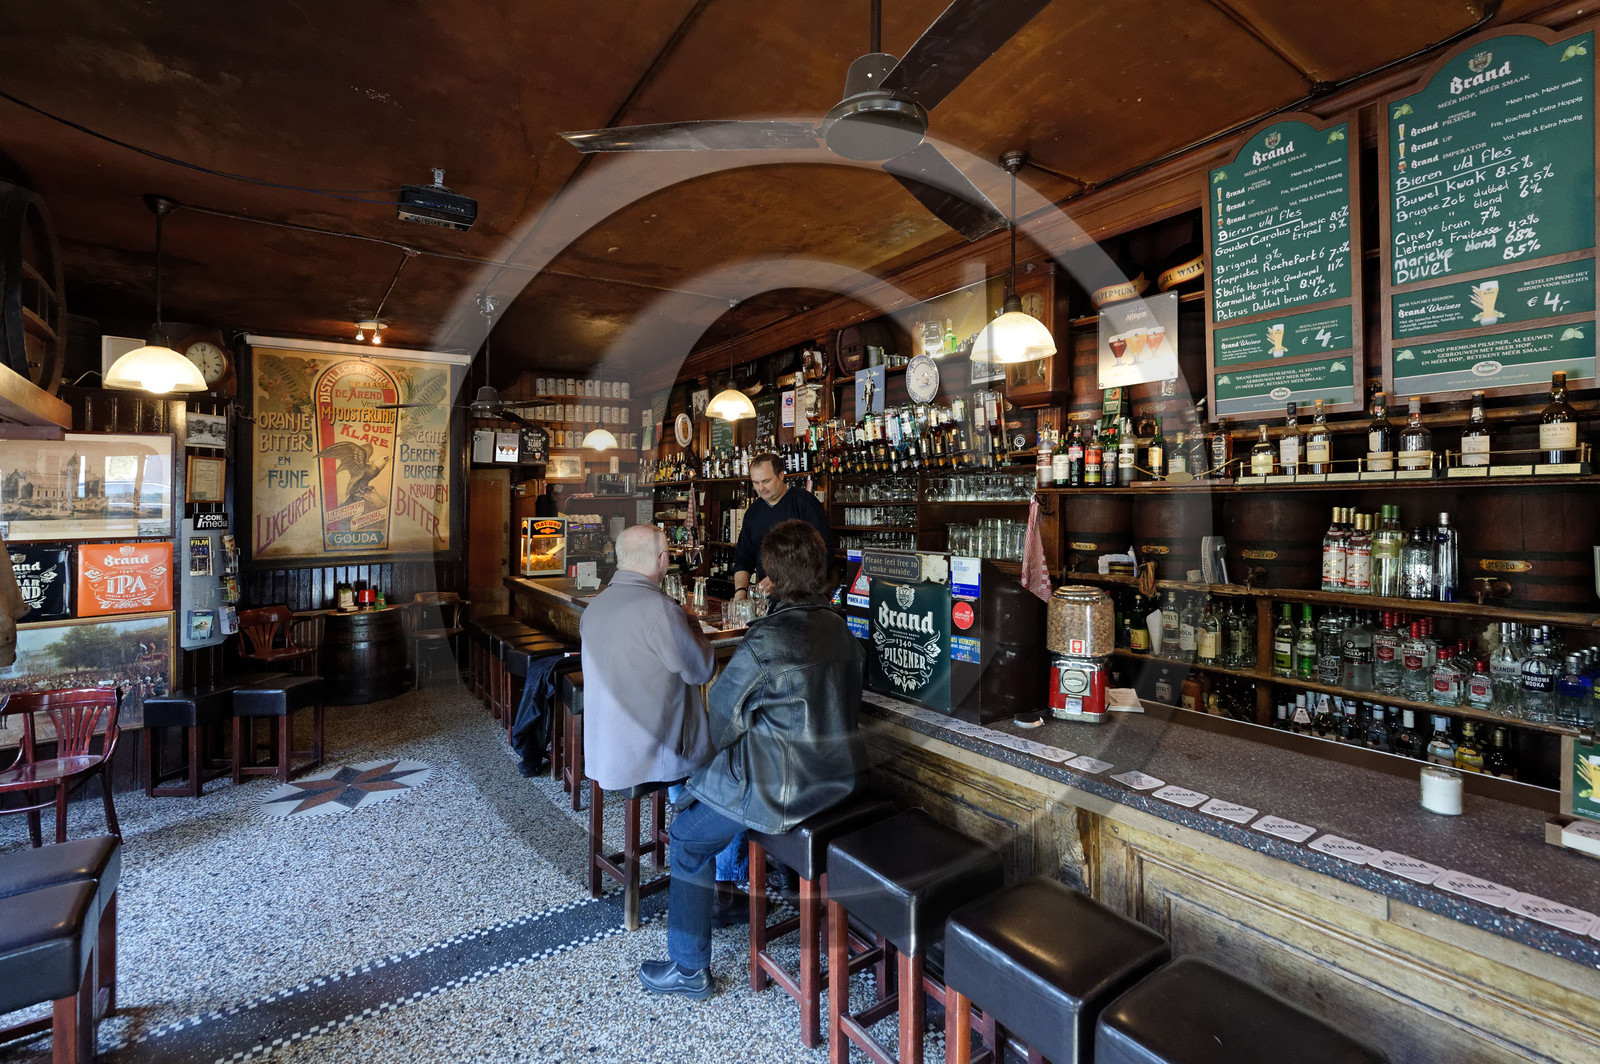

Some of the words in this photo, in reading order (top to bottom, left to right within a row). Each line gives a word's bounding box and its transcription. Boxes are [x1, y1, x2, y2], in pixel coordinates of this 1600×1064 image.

[1450, 61, 1512, 94] Brand
[1562, 77, 1582, 88] smaak
[1438, 99, 1457, 109] MÉÉR
[1459, 92, 1477, 103] HOP,
[1479, 83, 1500, 96] MÉÉR
[1502, 74, 1530, 89] SMAAK
[1505, 111, 1530, 124] Krachtig
[1540, 103, 1556, 114] Extra
[1558, 96, 1583, 108] Hoppig
[1411, 122, 1439, 137] Brand
[1442, 111, 1476, 126] PILSENER
[1517, 129, 1531, 137] Mild
[1540, 121, 1557, 130] Extra
[1559, 114, 1583, 125] Moutig
[1252, 141, 1294, 166] Brand
[1411, 138, 1439, 153] Brand
[1411, 155, 1439, 169] Brand
[1442, 142, 1487, 160] IMPERATOR
[1396, 170, 1442, 191] Bieren
[1226, 187, 1245, 199] Brand
[1396, 186, 1439, 210] Pauwel
[1396, 203, 1440, 222] Brugse
[1442, 193, 1465, 208] Zot
[1474, 180, 1509, 198] dubbel
[1474, 194, 1502, 209] blond
[1519, 182, 1542, 198] 6%
[1218, 225, 1252, 241] Bieren
[1292, 224, 1322, 240] tripel
[1329, 218, 1347, 232] 9%
[1395, 229, 1434, 245] Ciney
[1441, 220, 1471, 232] bruin
[1481, 206, 1500, 225] 7%
[1215, 242, 1248, 257] Gouden
[1250, 227, 1290, 246] Carolus
[1294, 218, 1326, 232] classic
[1396, 238, 1443, 258] Liefmans
[1450, 226, 1503, 243] Fruitesse
[1464, 235, 1497, 252] blond
[1215, 268, 1259, 286] Trappistes
[1263, 249, 1316, 272] Rochefort
[1319, 247, 1325, 258] 6
[1216, 254, 1258, 274] Brigand
[1265, 248, 1282, 262] 9%
[1247, 276, 1280, 291] Hendrik
[1328, 257, 1344, 272] 11%
[1261, 283, 1289, 297] Tripel
[1216, 308, 1248, 321] Petrus
[1252, 297, 1280, 312] Dubbel
[1284, 294, 1308, 304] bruin
[1398, 307, 1425, 318] Brand
[1427, 303, 1461, 312] Weizen
[1527, 297, 1538, 307] €
[1437, 349, 1478, 358] GEBROUWEN
[1446, 344, 1476, 352] PREMIUM
[335, 389, 347, 398] DE
[347, 388, 382, 402] AREND
[258, 411, 313, 434] ORANJE
[363, 424, 392, 433] OUDE
[259, 433, 313, 453] BITTER
[339, 423, 389, 448] KLARE
[417, 430, 447, 445] ECHTE
[277, 456, 291, 466] EN
[400, 443, 441, 464] BEREN-
[404, 464, 445, 481] BURGER
[409, 483, 448, 504] KRUIDEN
[256, 485, 317, 554] LIKEUREN
[394, 486, 446, 543] BITTER
[334, 534, 378, 544] GOUDA
[104, 555, 149, 567] Brand
[865, 556, 883, 565] Please
[884, 557, 896, 565] feel
[897, 559, 909, 567] free
[888, 567, 913, 576] outside.
[106, 574, 147, 595] IPA
[878, 601, 935, 636] Brand
[896, 639, 912, 648] 1340
[884, 647, 927, 671] PILSENER
[1263, 823, 1300, 831] Brand
[1321, 842, 1364, 853] Brand
[1382, 860, 1429, 870] Brand
[1448, 880, 1498, 891] Brand
[1522, 904, 1576, 916] Brand
